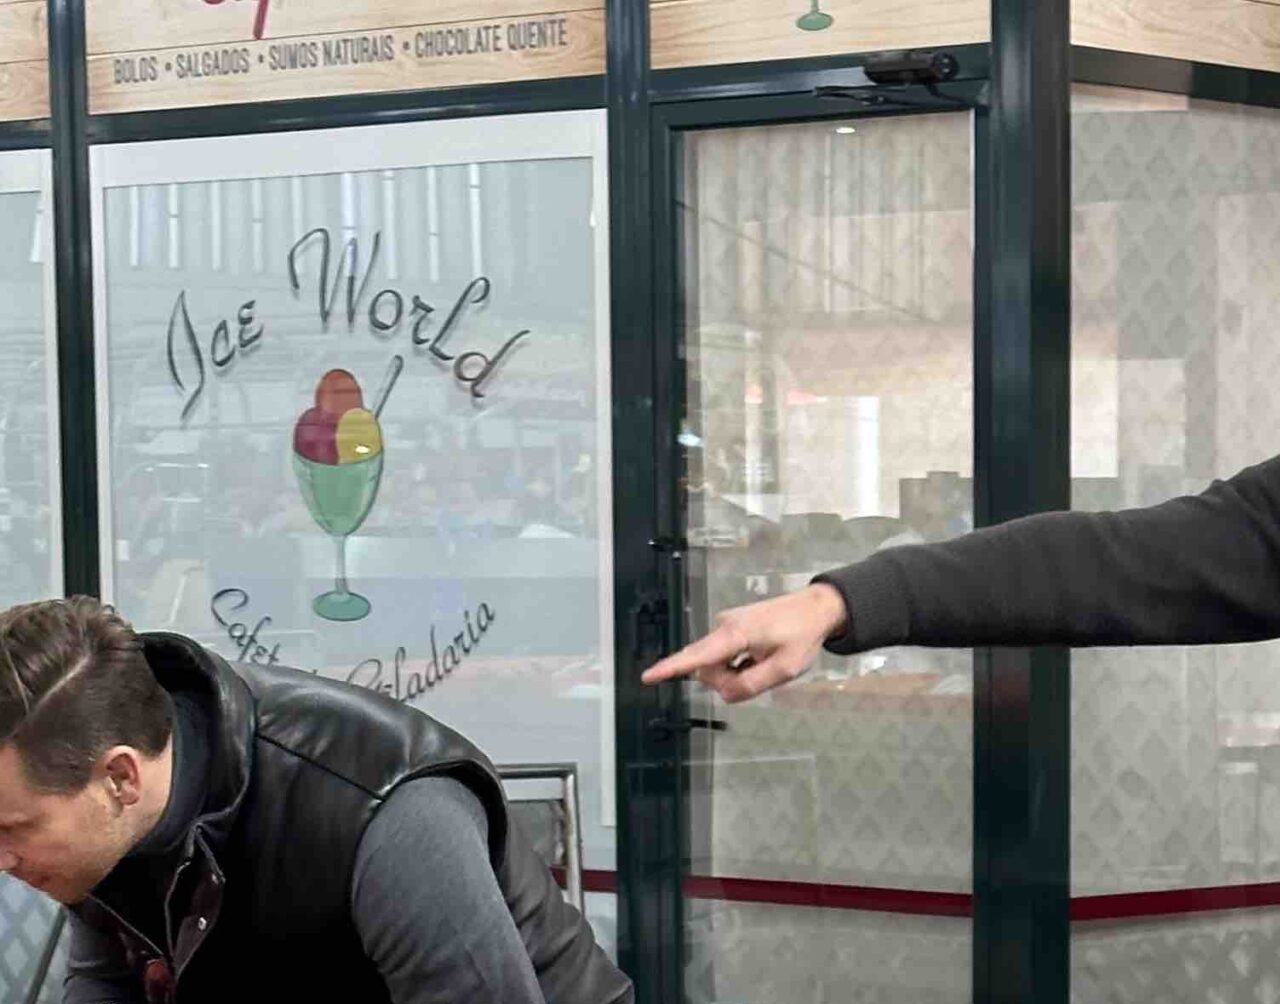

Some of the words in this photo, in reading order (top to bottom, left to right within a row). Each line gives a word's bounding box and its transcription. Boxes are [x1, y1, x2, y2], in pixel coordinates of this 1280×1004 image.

[114, 56, 157, 84] BOLOS
[176, 48, 249, 79] SALGADOS
[268, 41, 319, 71] SUMOS
[323, 34, 394, 66] NATURAIS
[415, 25, 502, 59] CHOCOLATE
[507, 19, 567, 51] QUENTE
[287, 227, 531, 400] World
